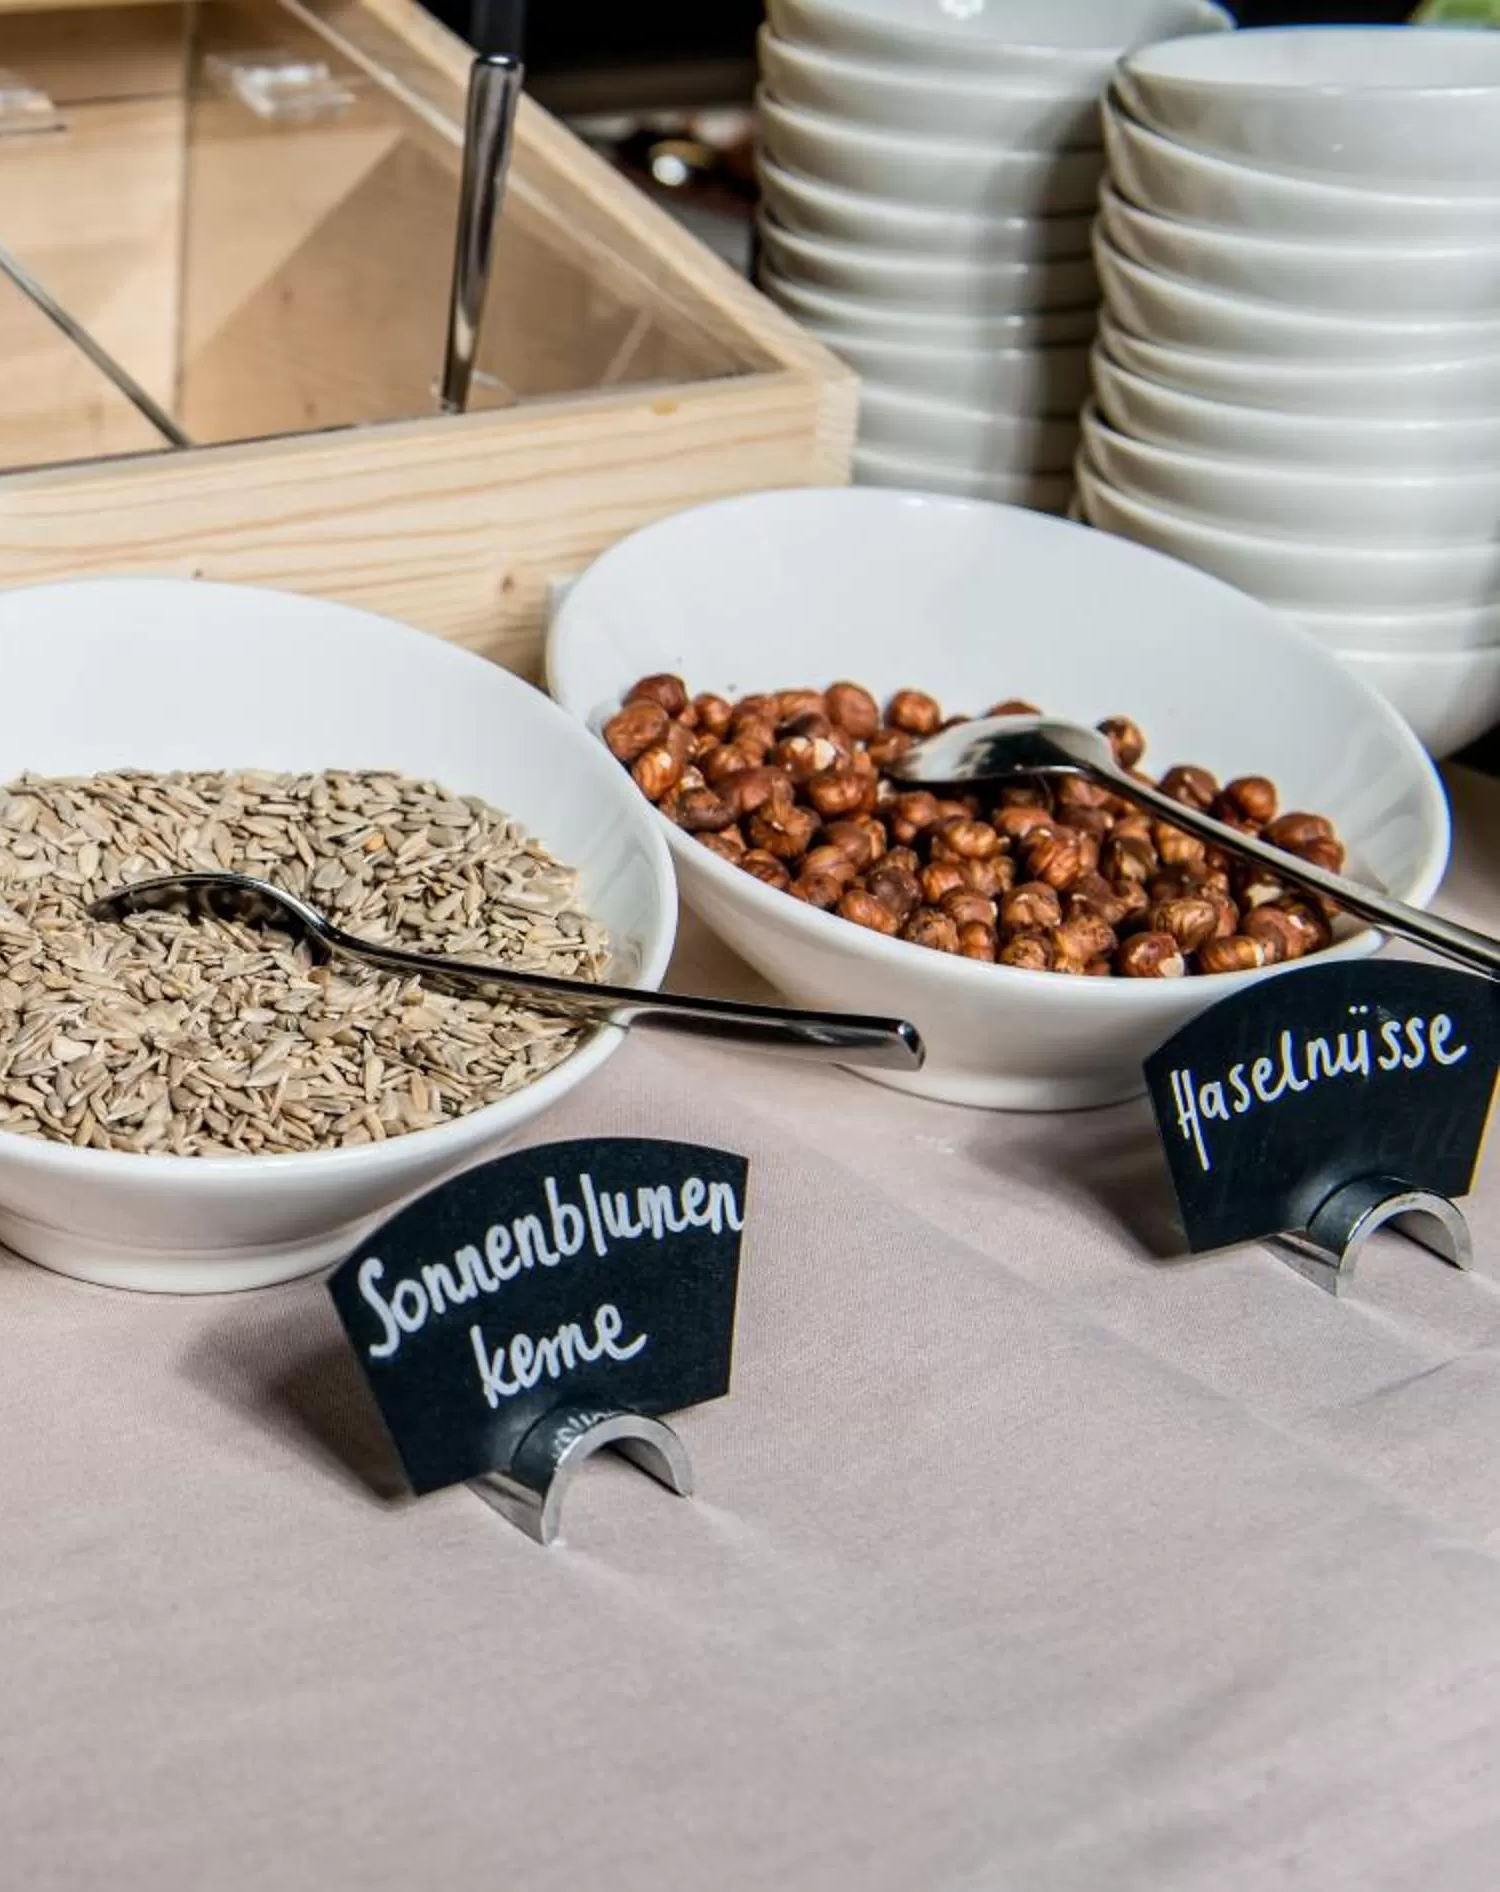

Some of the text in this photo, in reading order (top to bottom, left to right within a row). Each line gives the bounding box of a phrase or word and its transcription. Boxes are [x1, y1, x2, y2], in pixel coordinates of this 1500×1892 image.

[1170, 1004, 1468, 1172] Haselnüsse
[357, 1172, 745, 1359] Sonnenblumen
[468, 1303, 648, 1409] kerne
